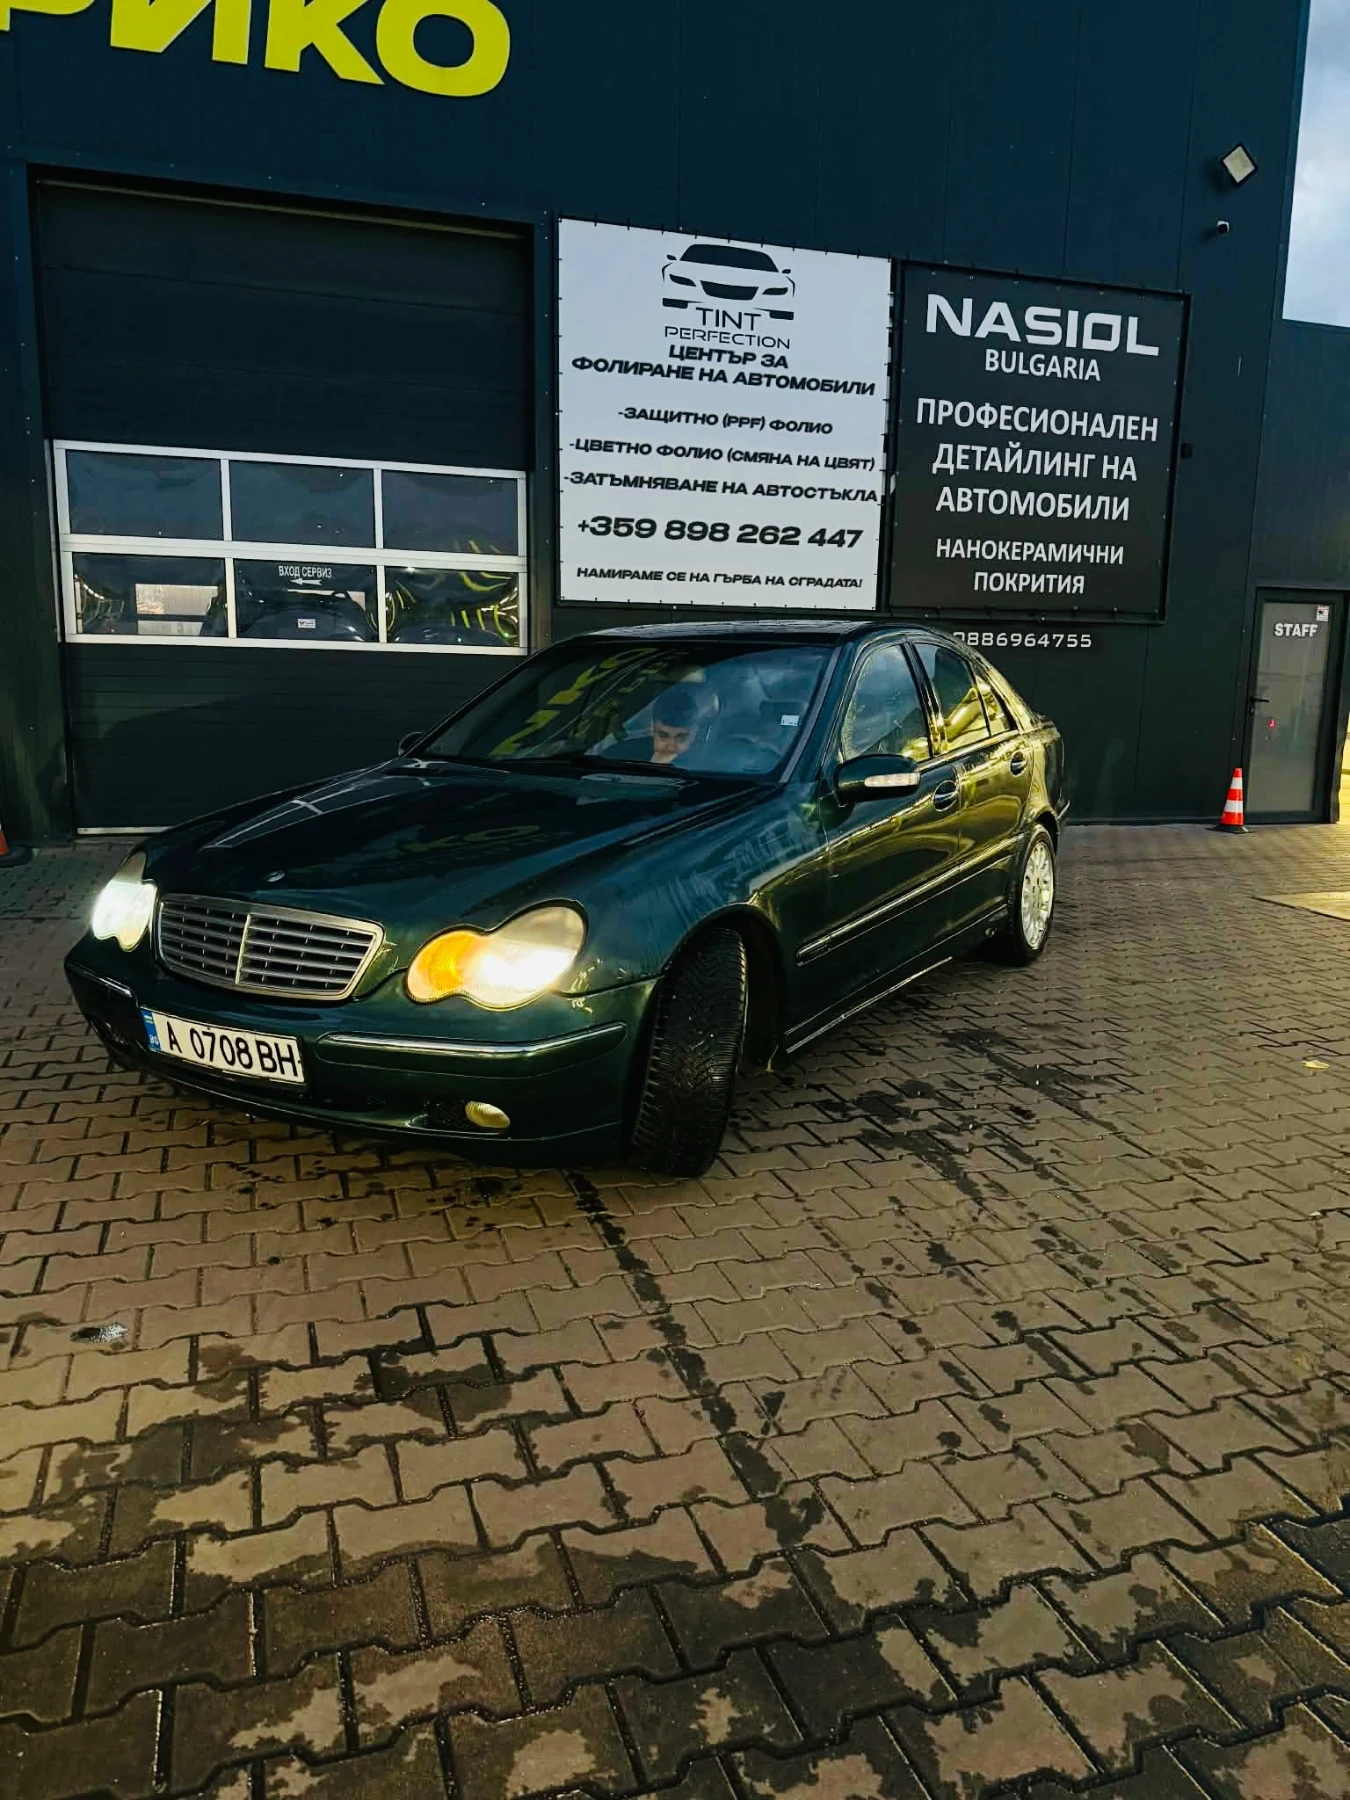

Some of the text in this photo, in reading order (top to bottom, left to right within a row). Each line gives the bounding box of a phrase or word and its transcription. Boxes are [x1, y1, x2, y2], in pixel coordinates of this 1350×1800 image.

[695, 307, 762, 331] TINT
[925, 293, 1160, 357] NASIOL
[664, 326, 791, 350] PERFECTION
[668, 345, 789, 369] ЦЕНТЪР ЗА
[984, 348, 1101, 382] BULGARIA
[571, 356, 876, 397] ФОЛИРАНЕ НА АВТОМОБИЛИ
[618, 407, 719, 426] -ЗАЩИТНО
[769, 419, 834, 435] ФОЛИО
[916, 397, 1159, 442] ПРОФЕСИОНАЛЕН
[569, 438, 876, 472] -ЦВЕТНО ФОЛИО (СМЯНА НА ЦВЯТ)
[932, 441, 1138, 482] ДЕТАЙЛИНГ НА
[563, 471, 879, 503] -ЗАТЪМНЯВАНЕ НА АВТОСТЪКЛА
[935, 485, 1130, 522] АВТОМОБИЛИ
[577, 515, 865, 549] +359 898 262 447
[935, 537, 1125, 566] НАНОКЕРАМИЧНИ
[278, 565, 332, 579] ВХОД СЕРВИЗ
[576, 567, 663, 581] НАМИРАМЕ
[666, 571, 687, 582] СЕ
[689, 572, 711, 583] НА
[713, 573, 762, 586] ГЪРБА
[764, 576, 786, 587] НА
[973, 571, 1086, 595] ПОКРИТИЯ
[1274, 623, 1318, 637] STAFF
